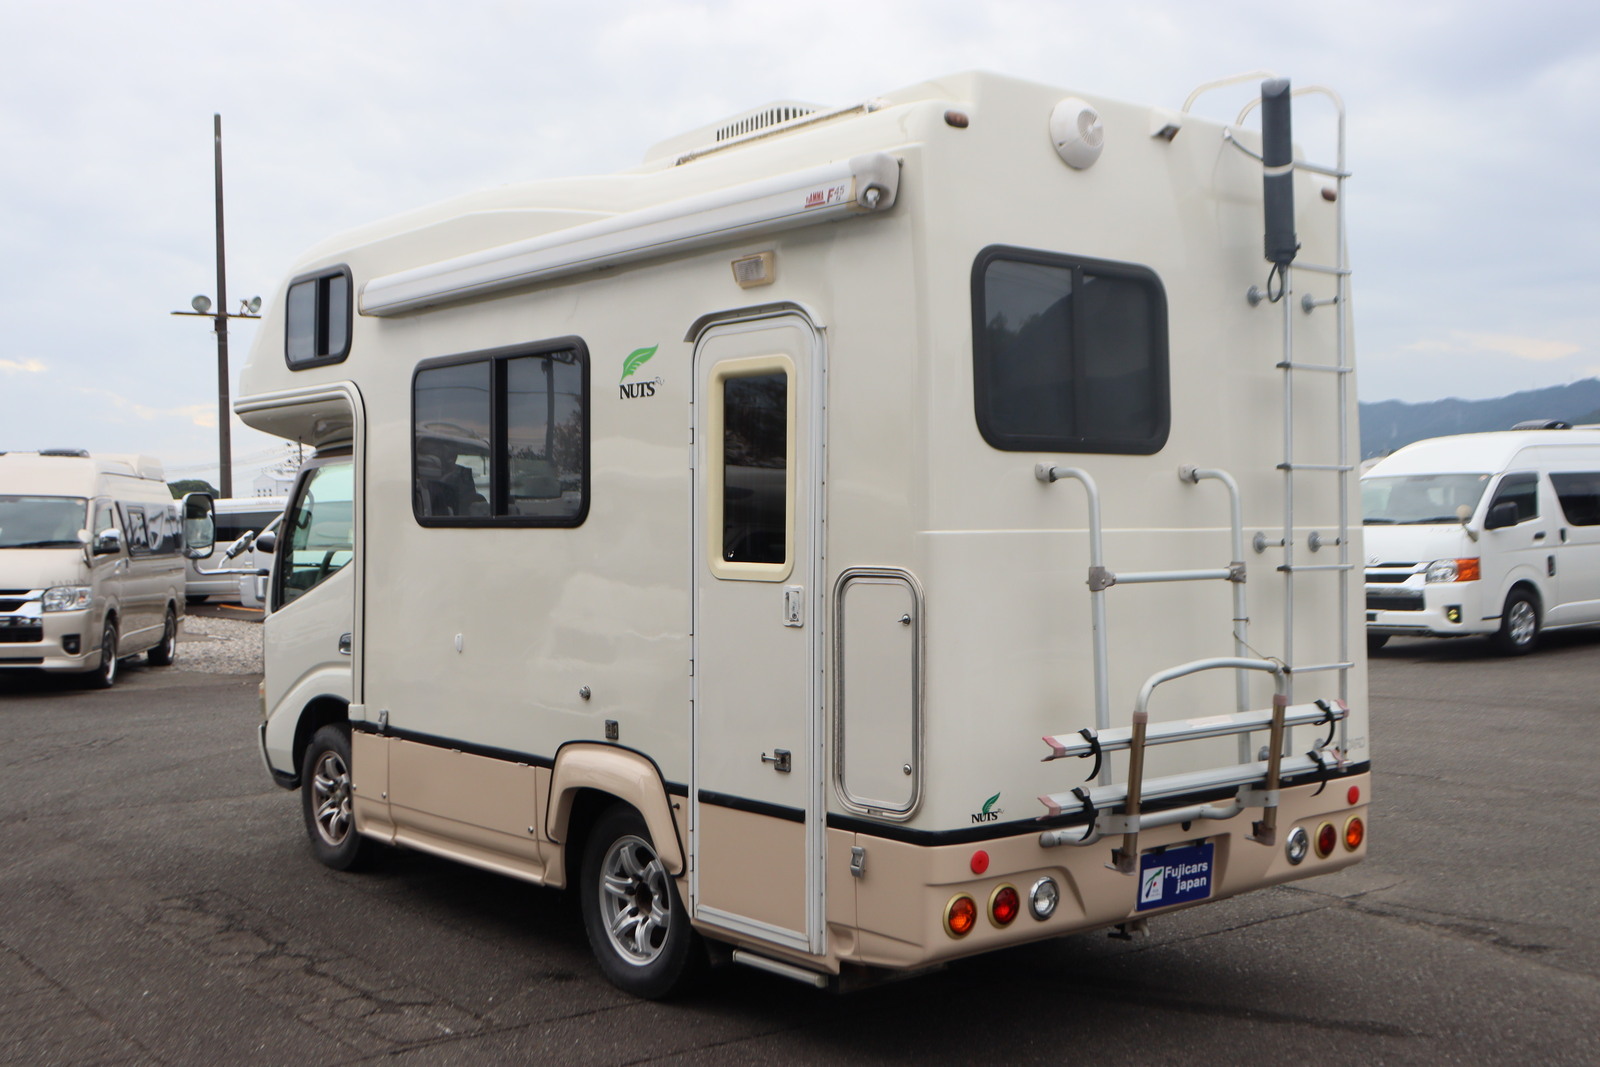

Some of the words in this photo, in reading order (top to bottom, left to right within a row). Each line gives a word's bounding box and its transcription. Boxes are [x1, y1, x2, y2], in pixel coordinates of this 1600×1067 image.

[619, 381, 656, 400] NUTS
[971, 811, 998, 824] NUTS
[1164, 862, 1209, 880] Fujicars
[1175, 876, 1207, 895] japan
